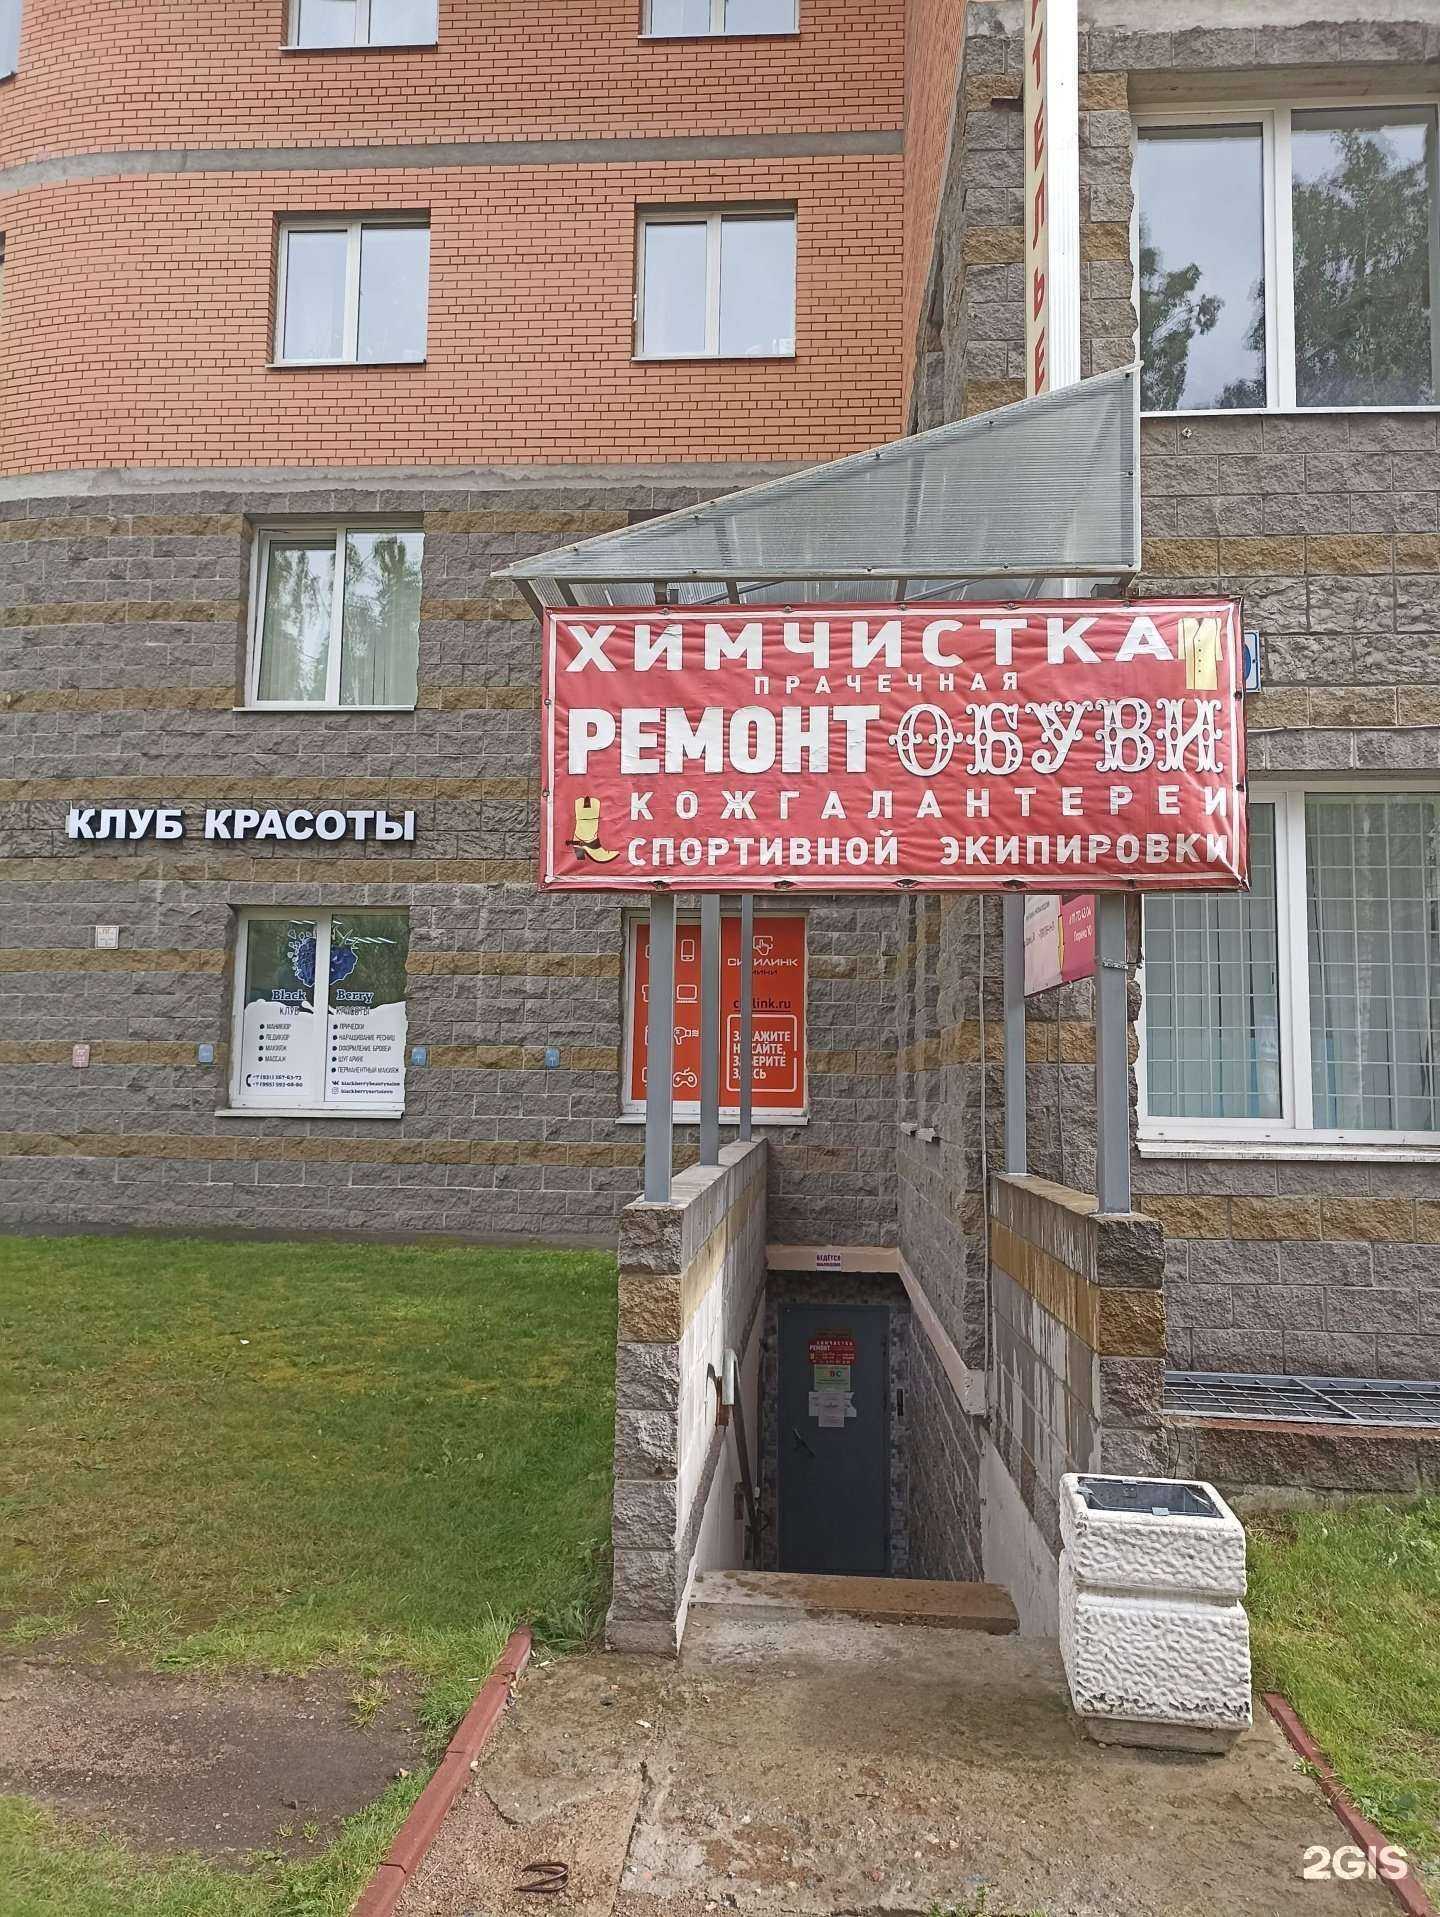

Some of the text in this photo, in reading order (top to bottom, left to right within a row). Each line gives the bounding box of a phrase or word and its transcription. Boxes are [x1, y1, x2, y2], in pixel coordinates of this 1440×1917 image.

[566, 616, 1174, 673] ХИМЧИСТКА
[754, 671, 1018, 695] ПРАЧЕЧНАЯ
[568, 697, 1224, 777] РЕМОНТ ОБУВИ
[629, 785, 1228, 821] КОЖГАЛАНТЕРЕИ
[68, 808, 416, 841] КЛУБ КРАСОТЫ
[627, 829, 1229, 866] СПОРТИВНОЙ ЭКИПИРОВКИ
[727, 958, 799, 966] СИИЛИНК
[272, 989, 374, 1003] Black Berry
[733, 997, 791, 1009] clink.ru
[733, 1056, 786, 1067] ЗЕРИТЕ
